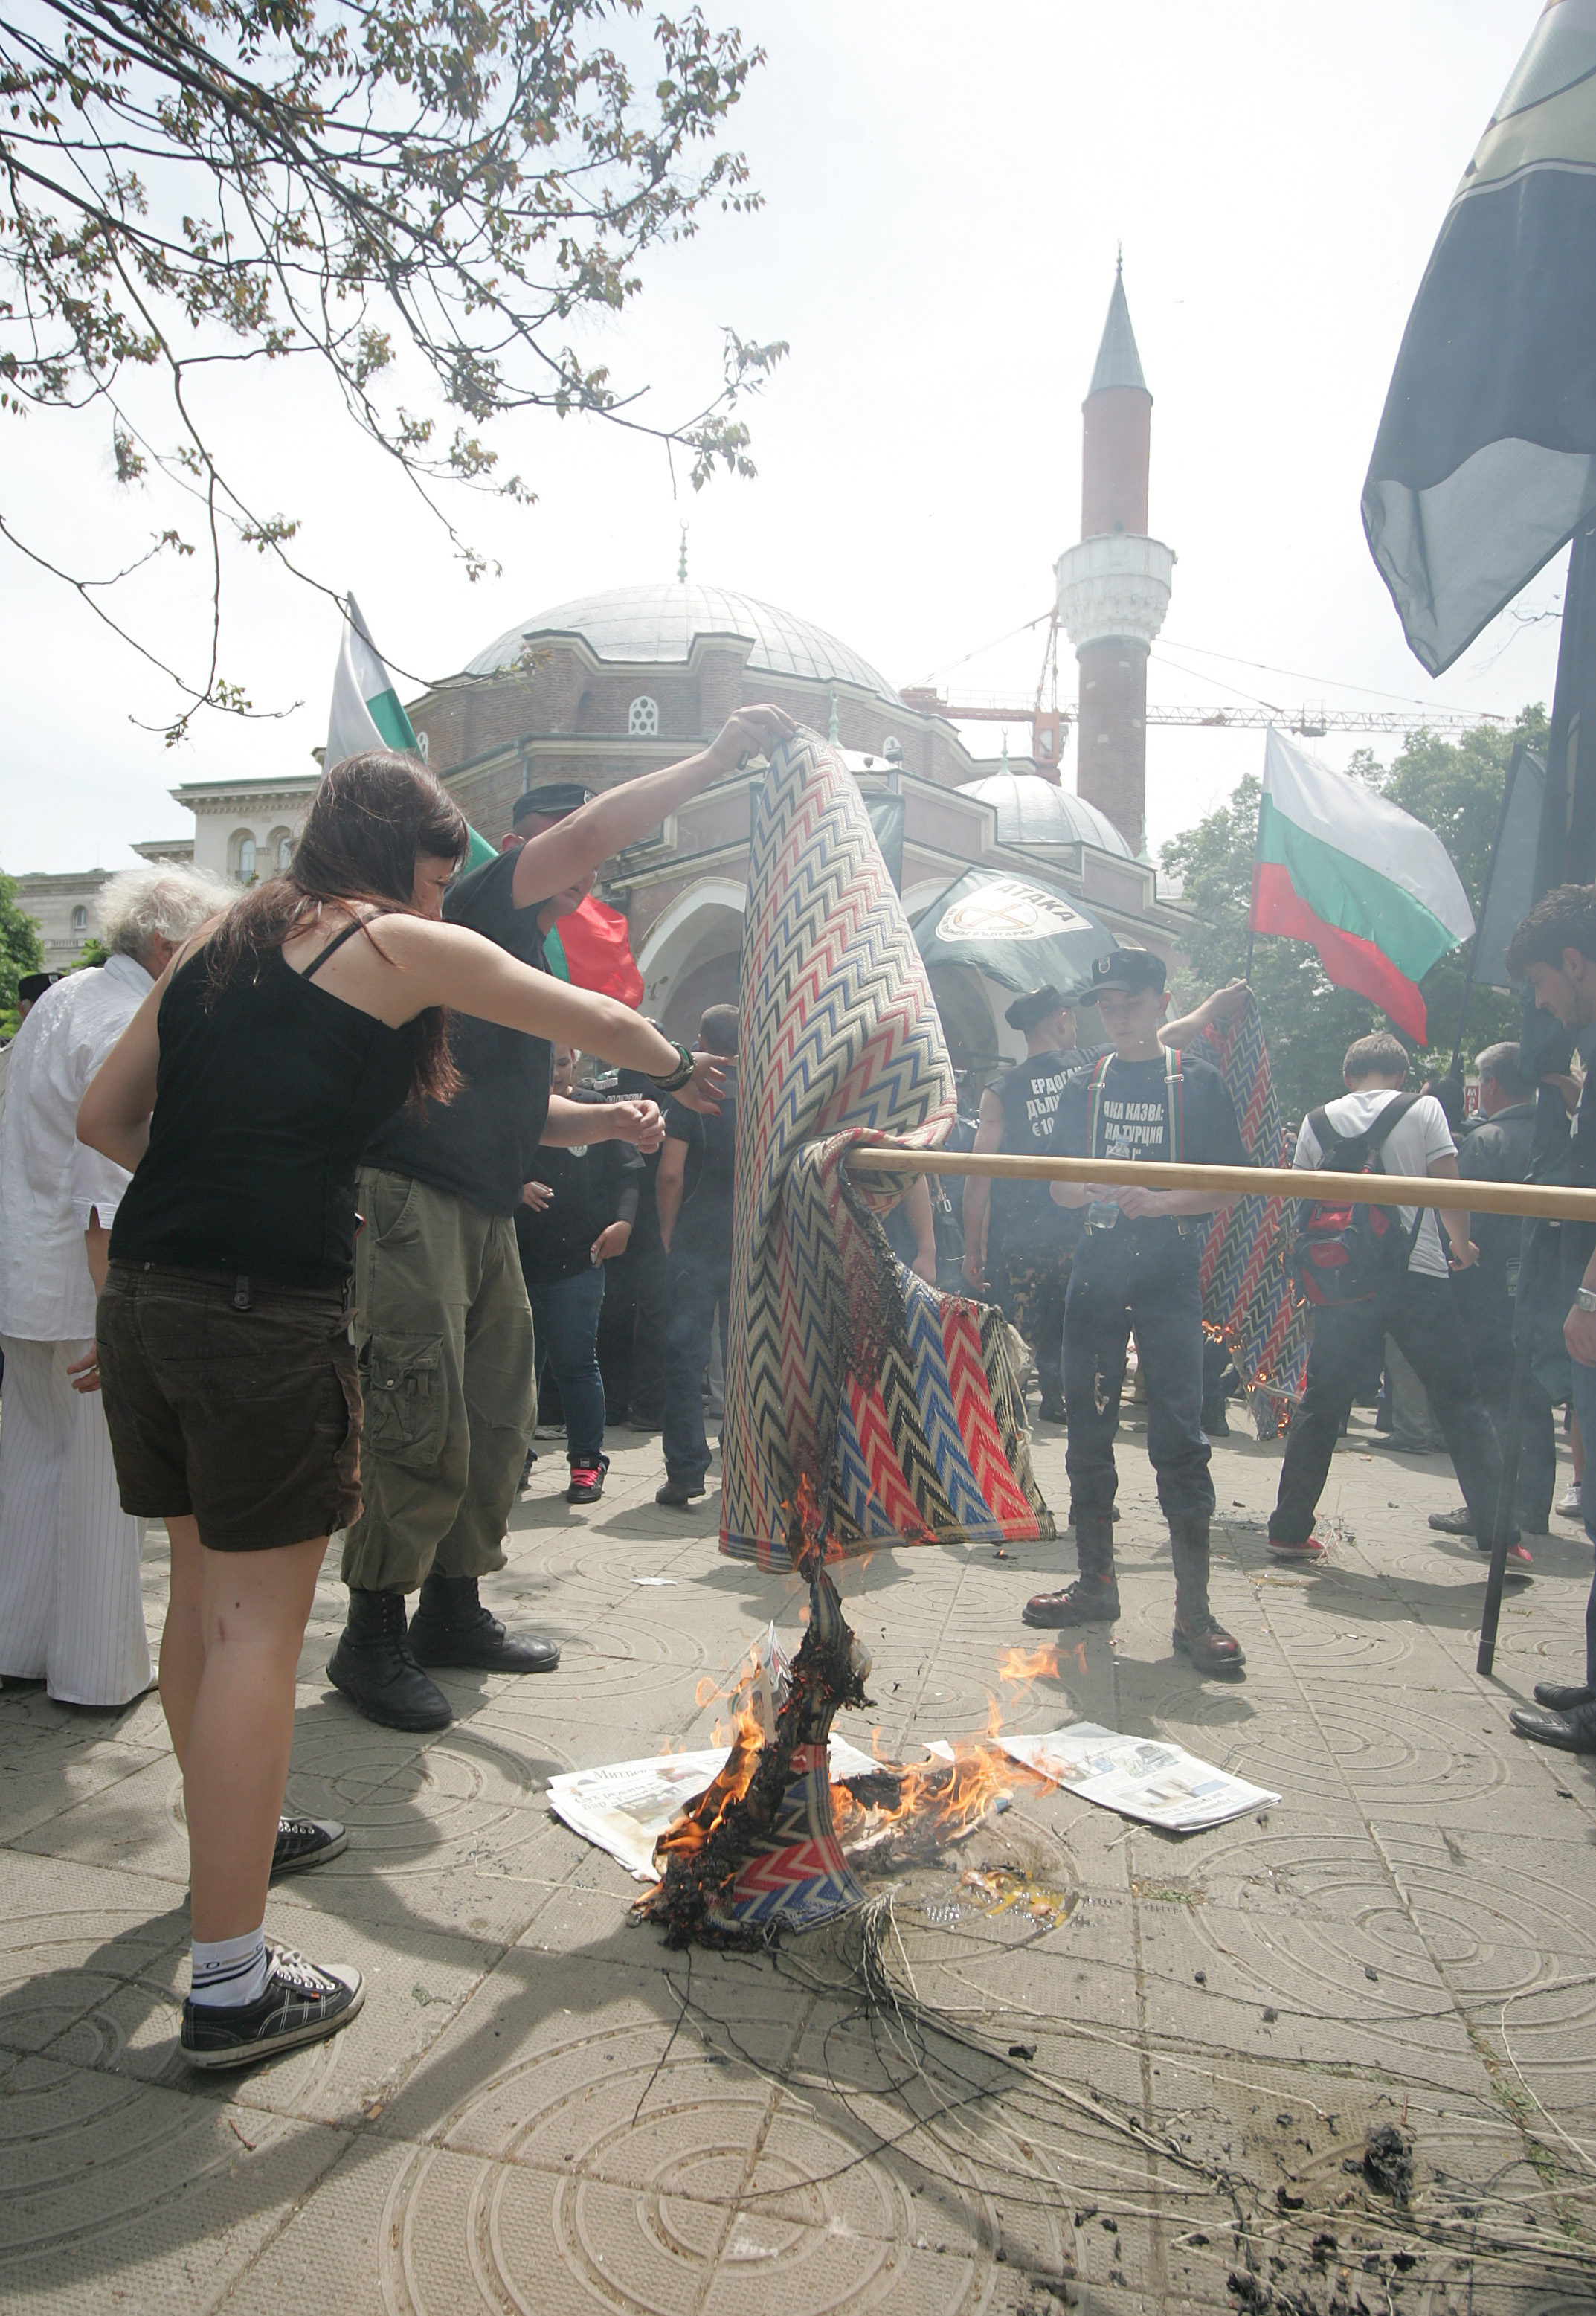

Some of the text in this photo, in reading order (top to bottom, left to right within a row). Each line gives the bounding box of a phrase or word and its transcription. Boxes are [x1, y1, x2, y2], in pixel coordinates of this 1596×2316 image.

[993, 884, 1076, 922] АТАКА
[971, 929, 1035, 937] БЪЛГАРИЯ
[1125, 1102, 1165, 1122] КАЗВА:
[1122, 1125, 1164, 1147] ТУРЦИЯ
